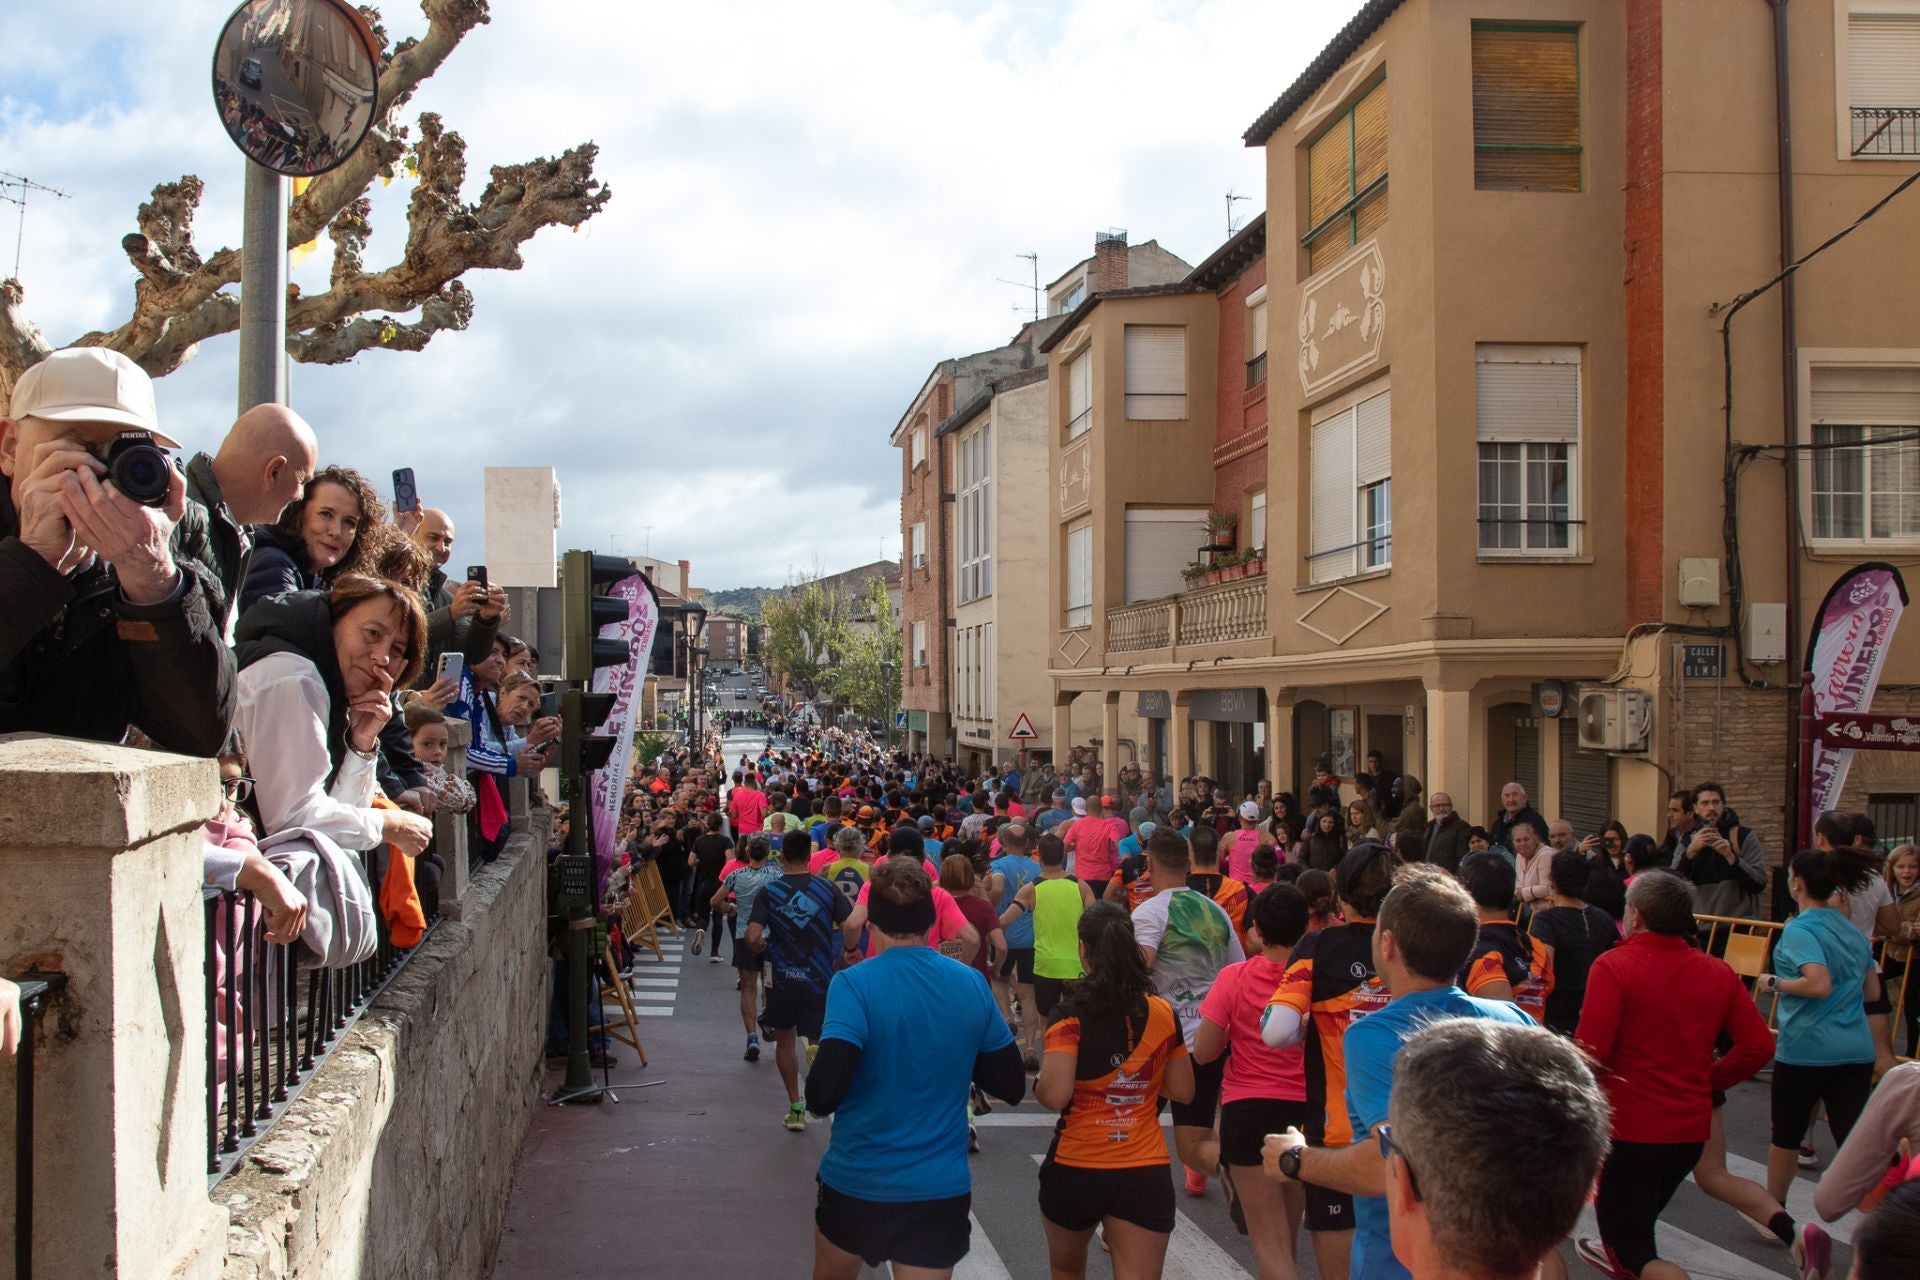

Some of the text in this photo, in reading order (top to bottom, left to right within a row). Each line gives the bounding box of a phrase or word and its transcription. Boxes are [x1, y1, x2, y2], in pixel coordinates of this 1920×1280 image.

[1691, 647, 1716, 656] CALLE
[1686, 665, 1718, 676] OLMO
[1220, 690, 1247, 712] BBVA
[1865, 731, 1896, 742] Valentín
[608, 761, 620, 812] MEMORIAL
[1819, 760, 1841, 811] MEMORIAL
[565, 867, 585, 875] VERDE
[565, 887, 584, 895] PULSE
